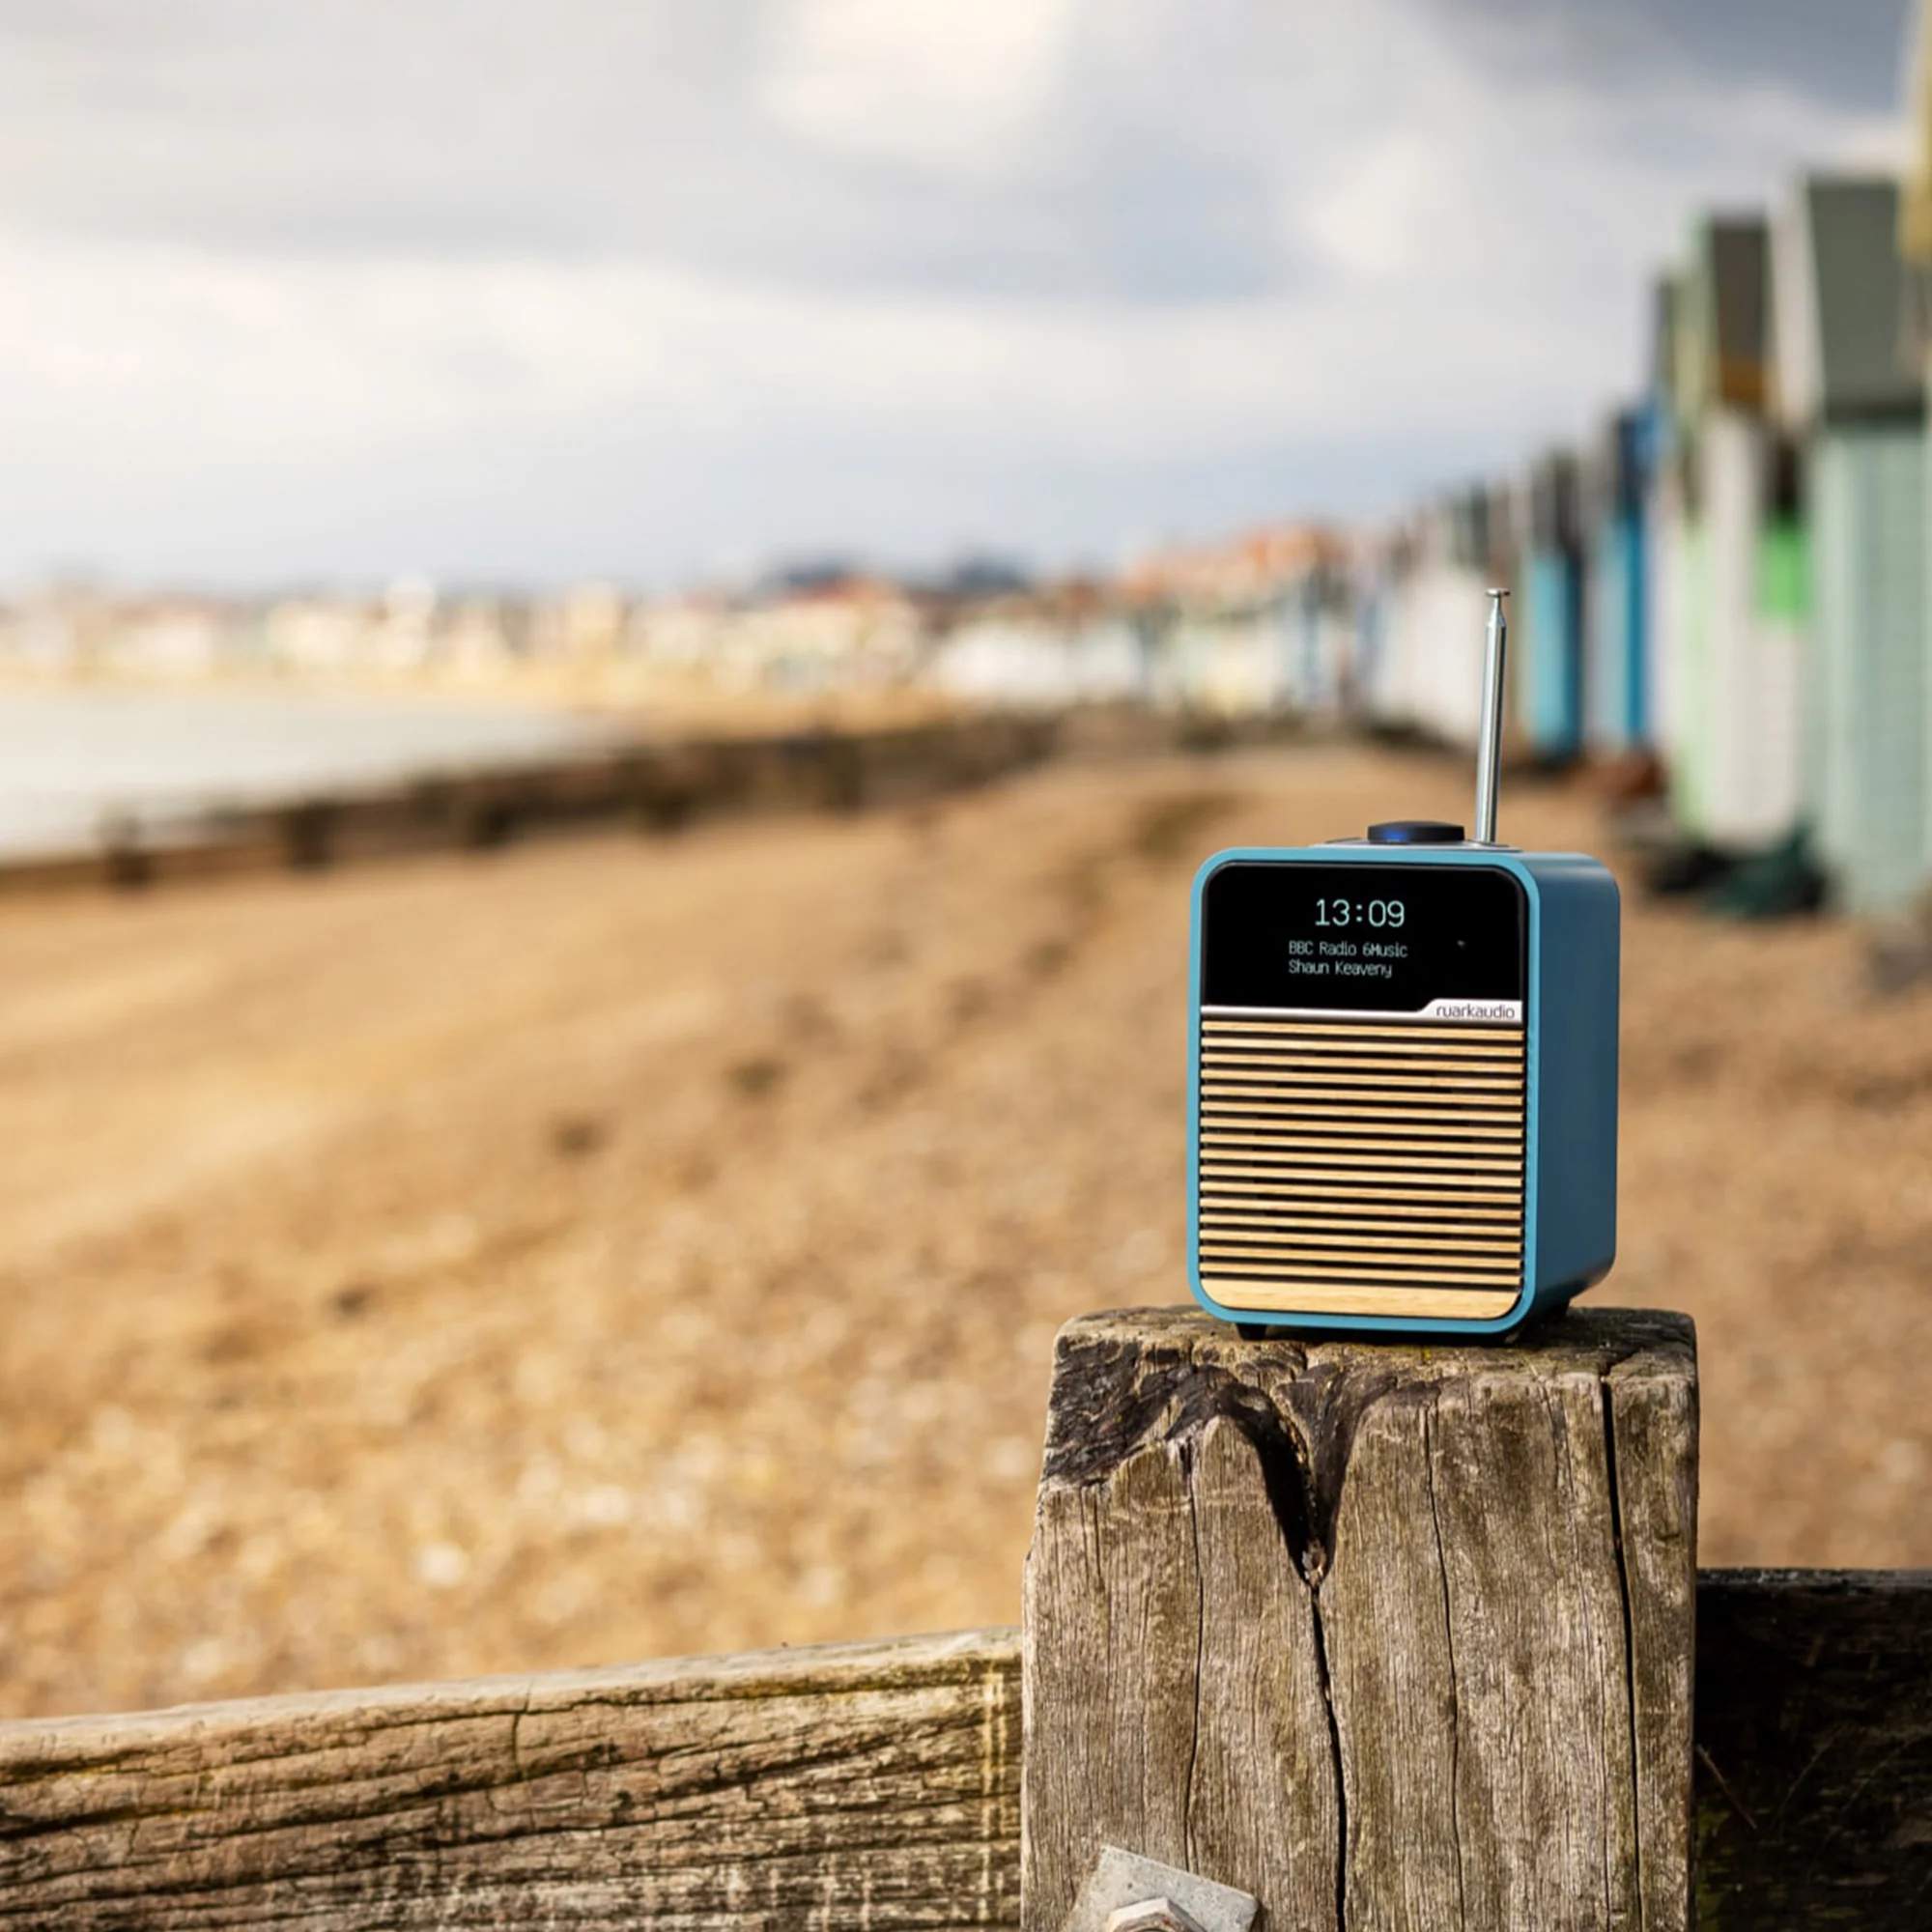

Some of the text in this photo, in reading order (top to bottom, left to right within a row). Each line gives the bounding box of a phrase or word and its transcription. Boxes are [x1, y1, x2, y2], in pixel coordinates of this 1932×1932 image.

[1315, 898, 1406, 927] 13:09
[1289, 940, 1408, 958] BBC Radio 6Music
[1288, 959, 1393, 979] Shaun Keaveny
[1435, 1002, 1516, 1019] ruarkaudio
